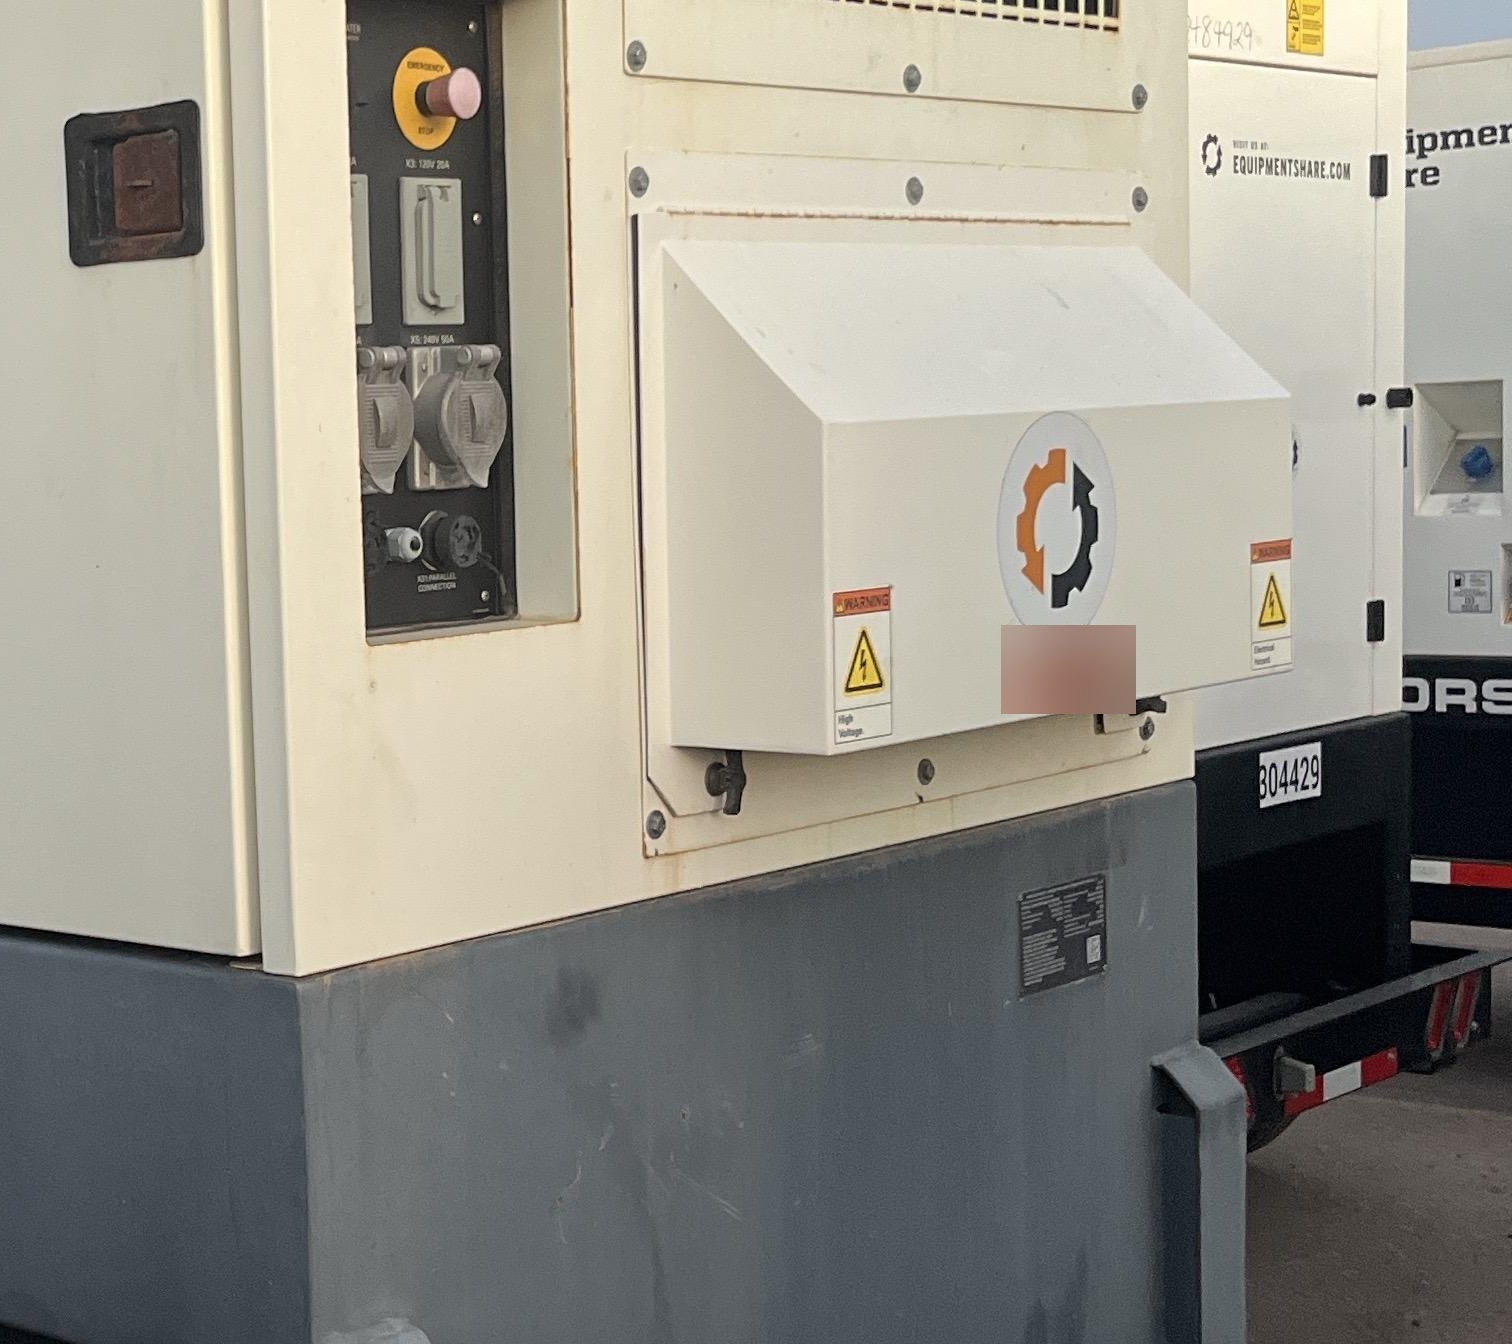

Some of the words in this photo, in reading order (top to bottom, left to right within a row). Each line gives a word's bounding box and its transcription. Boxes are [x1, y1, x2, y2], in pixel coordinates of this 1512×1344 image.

[406, 60, 445, 74] EMERGENCY
[417, 125, 434, 136] STOP
[1232, 154, 1351, 181] EQUIPMENTSHARE.COM
[843, 593, 890, 610] WARNING
